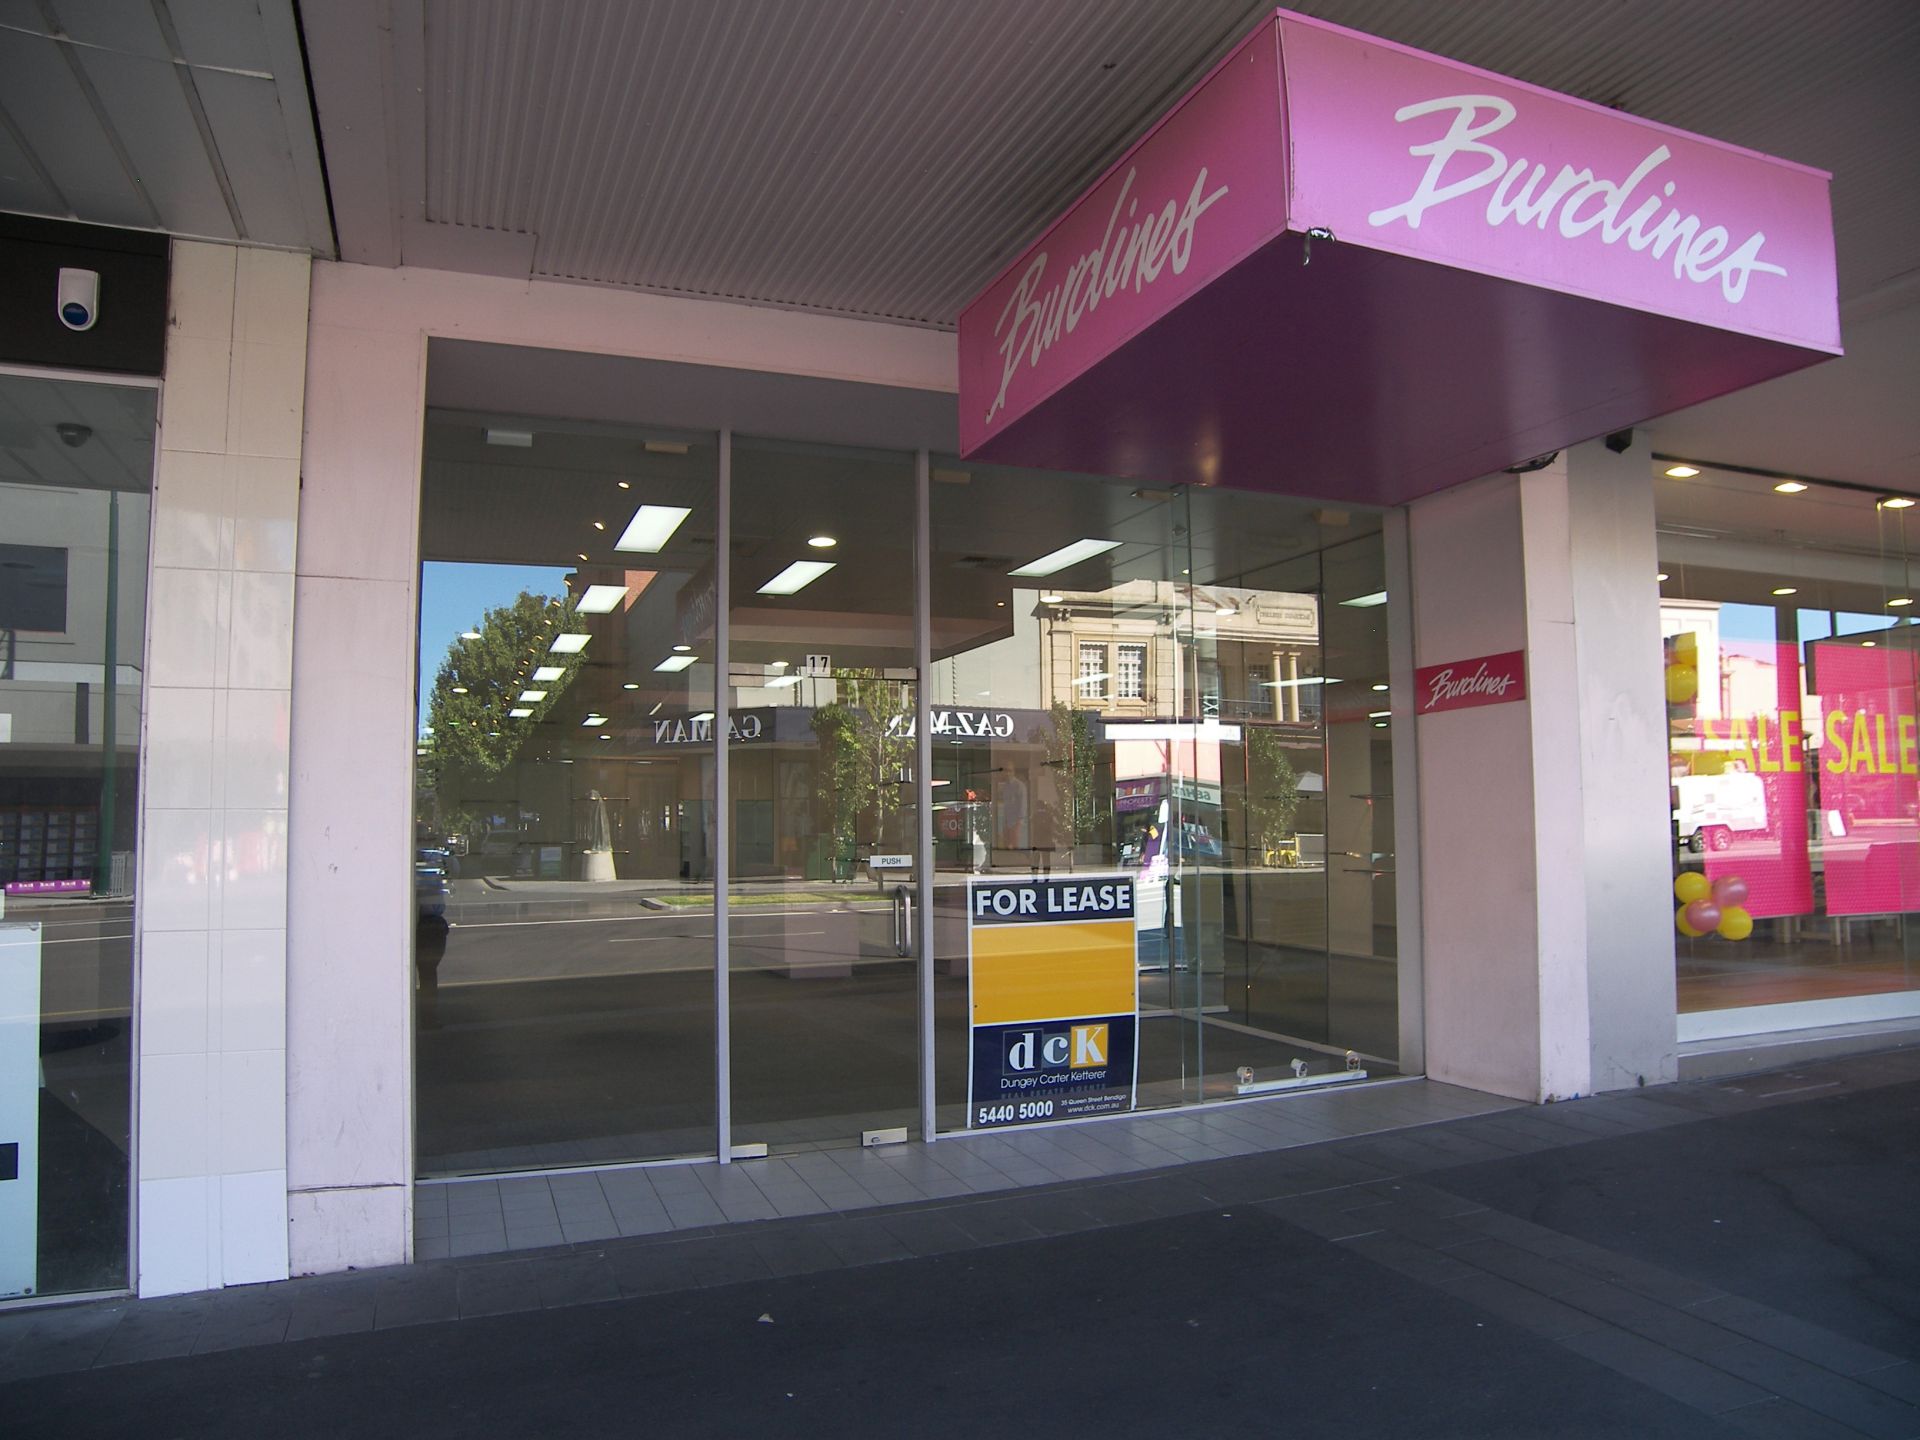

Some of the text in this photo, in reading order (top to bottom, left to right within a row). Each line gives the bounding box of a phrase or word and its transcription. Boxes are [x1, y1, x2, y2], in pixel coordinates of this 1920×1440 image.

[1369, 94, 1787, 303] Burdines
[985, 166, 1229, 425] Burdines
[809, 656, 829, 673] 17
[1424, 662, 1517, 709] Burdines
[1825, 710, 1918, 774] SALE
[881, 857, 902, 865] PUSH
[976, 884, 1131, 916] FOR LEASE
[1000, 1070, 1107, 1089] Dungey Carter Ketterer
[1067, 1102, 1120, 1114] www.dck.com.au
[1068, 1097, 1087, 1106] Queen
[1088, 1095, 1103, 1104] Street
[1103, 1093, 1127, 1103] Bendigo
[978, 1100, 1054, 1124] 5440 5000
